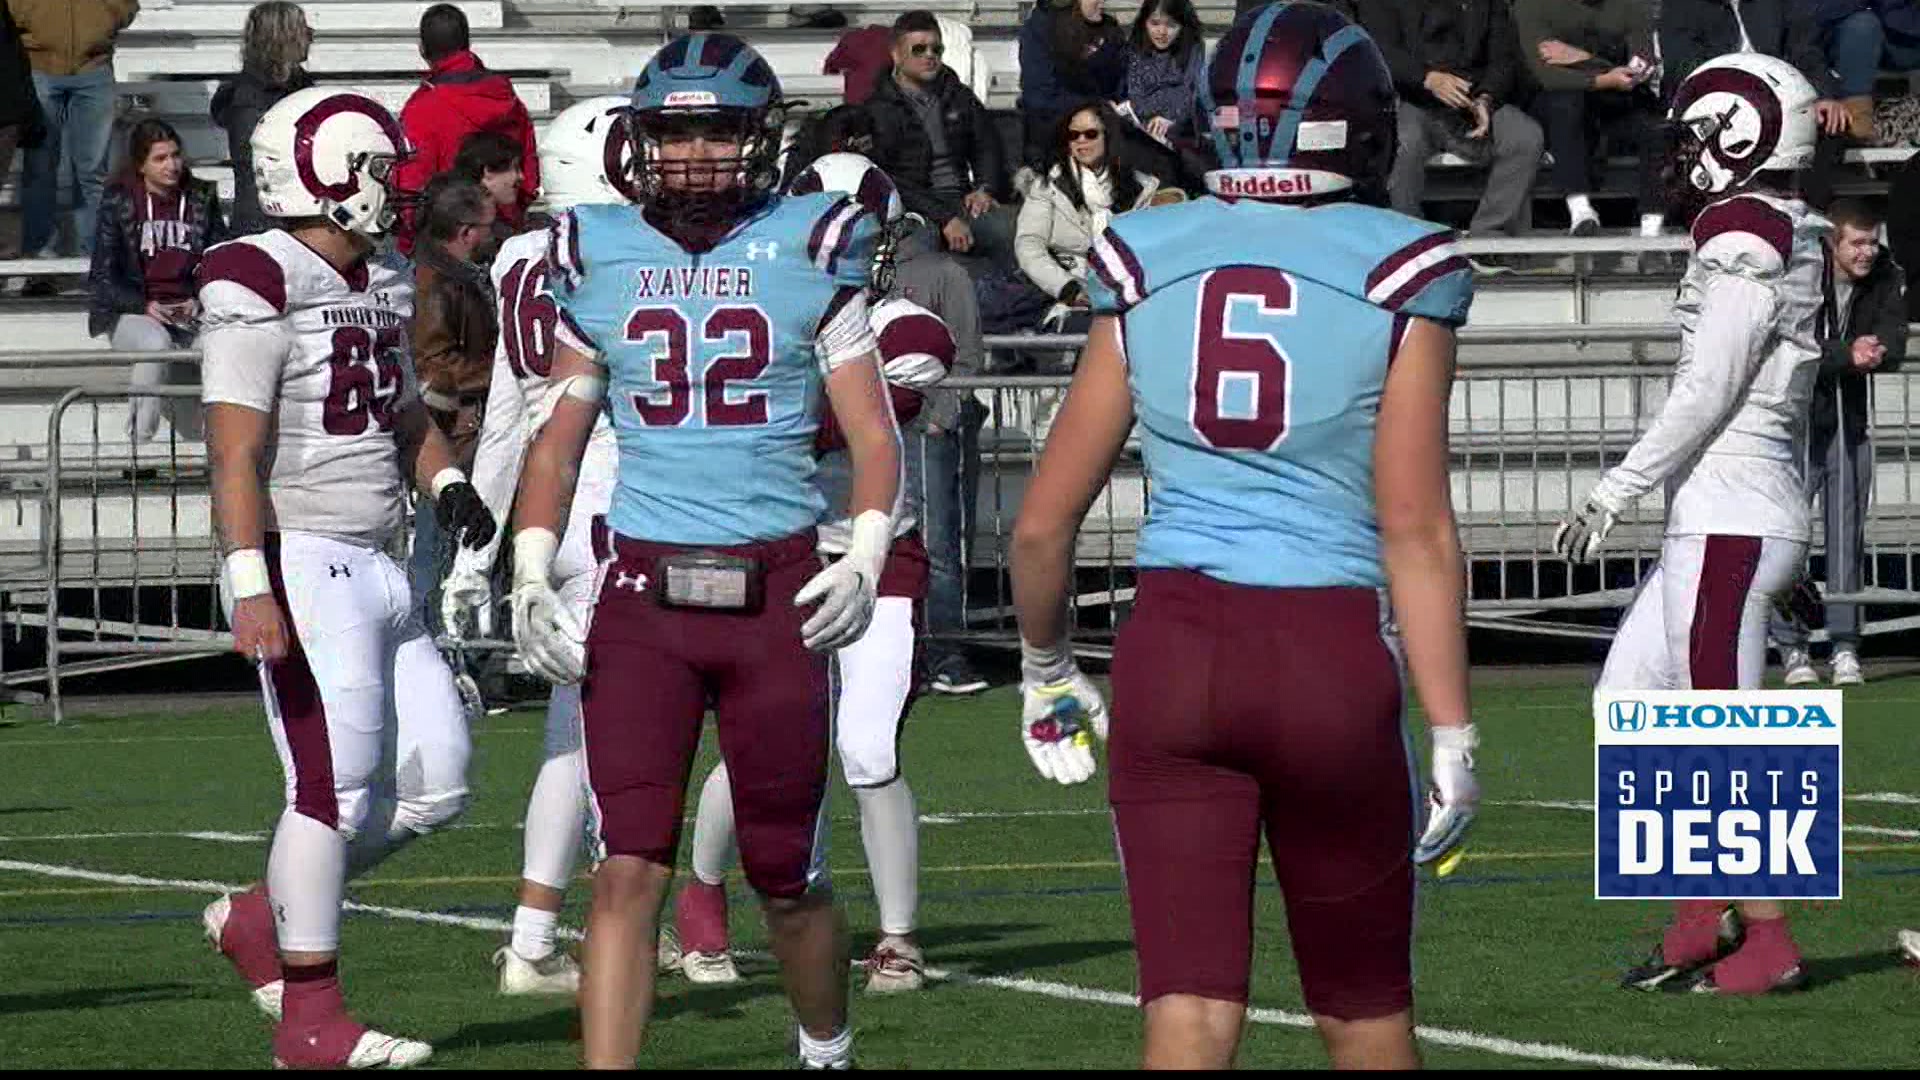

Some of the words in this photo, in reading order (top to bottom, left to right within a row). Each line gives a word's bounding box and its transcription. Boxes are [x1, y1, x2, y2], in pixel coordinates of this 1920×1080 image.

[1217, 173, 1312, 194] Riddell
[501, 258, 557, 378] 16
[637, 266, 754, 298] XAVIER
[624, 304, 772, 427] 32
[1189, 264, 1297, 453] 6
